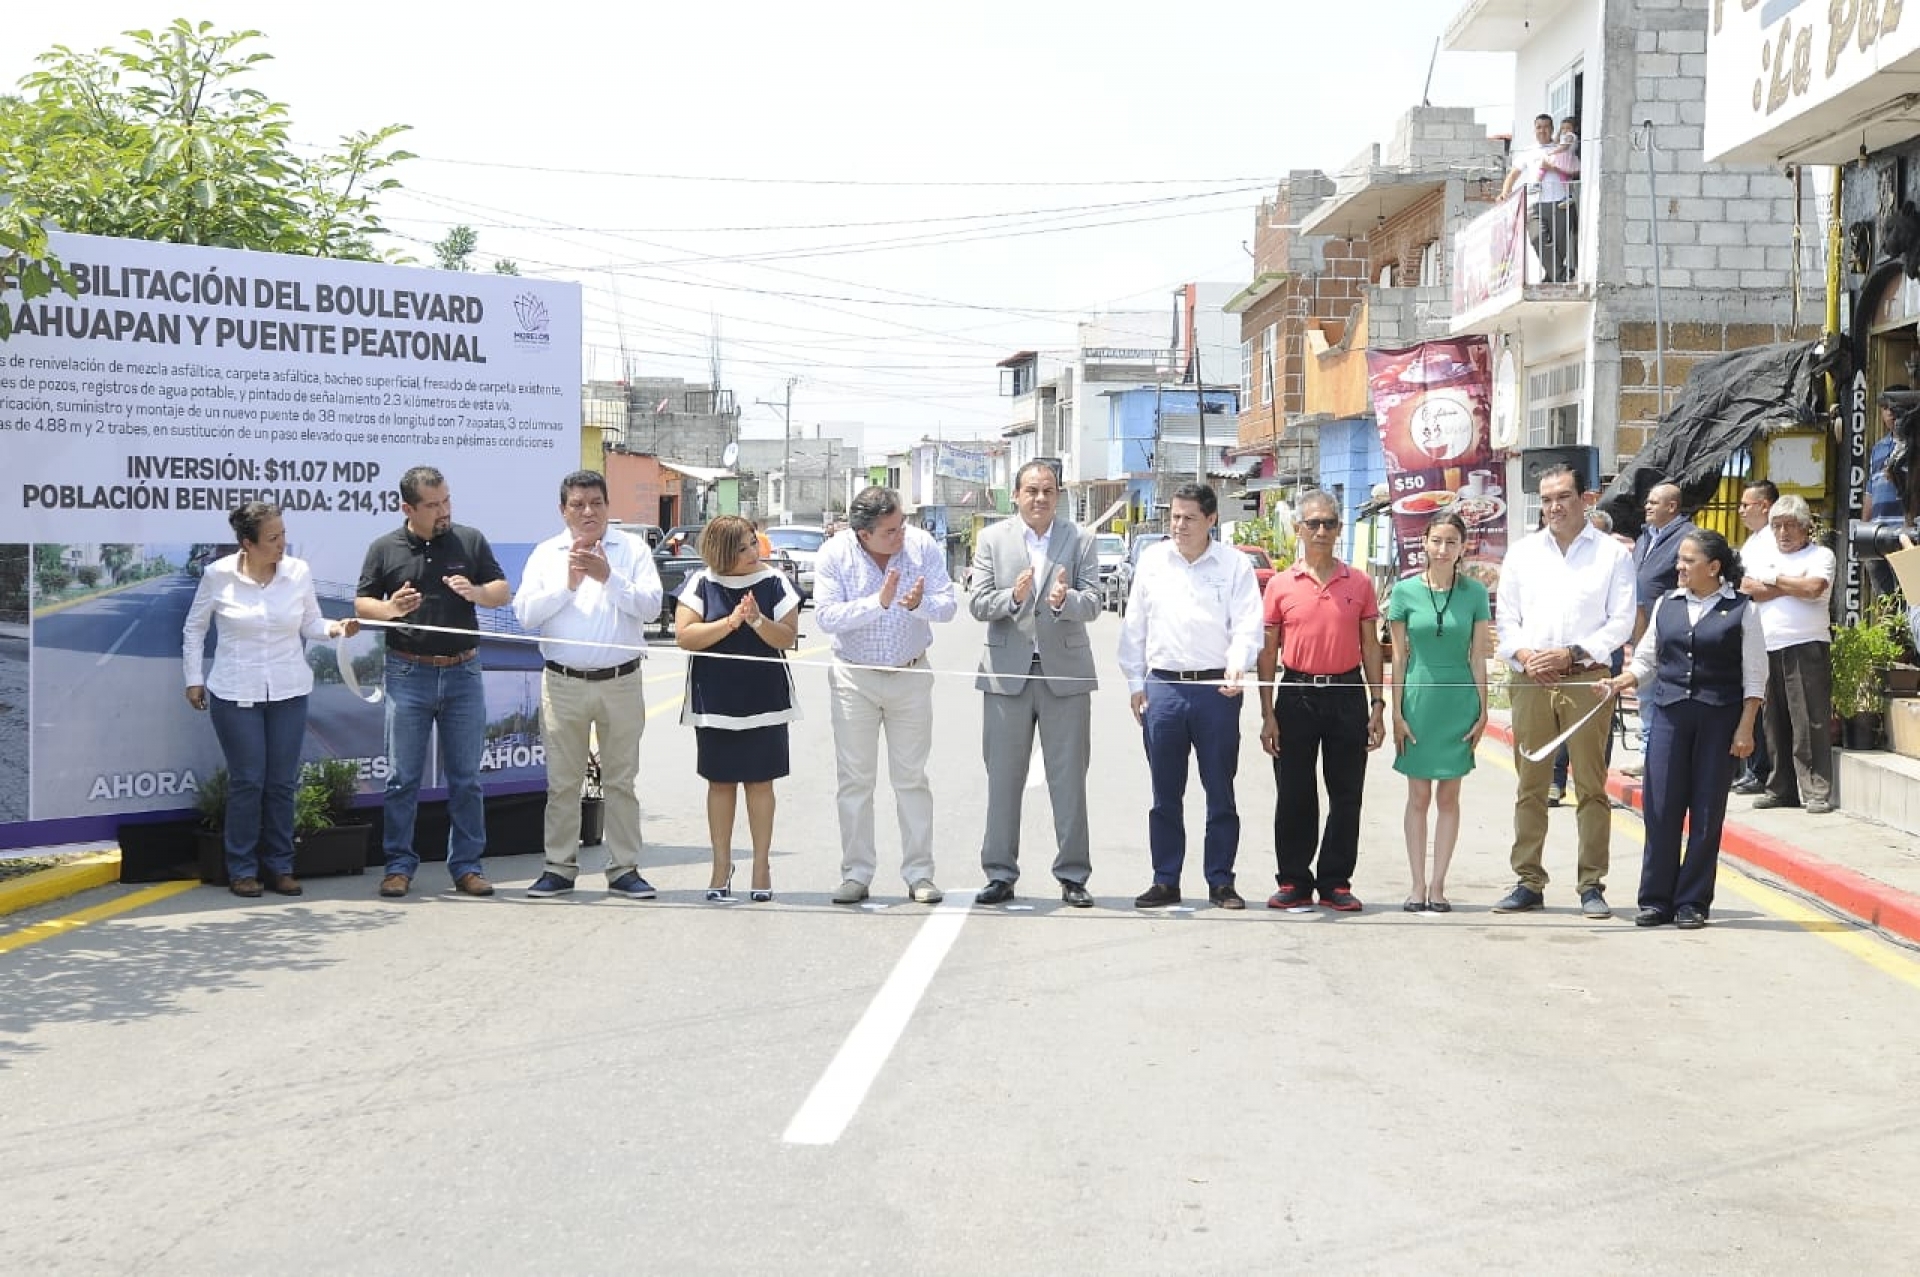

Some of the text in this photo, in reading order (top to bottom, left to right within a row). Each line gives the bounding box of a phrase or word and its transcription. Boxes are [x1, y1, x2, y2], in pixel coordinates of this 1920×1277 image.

[254, 278, 310, 312] DEL
[316, 284, 484, 325] BOULEVARD
[186, 314, 210, 346] Y
[215, 317, 336, 354] PUENTE
[341, 326, 487, 364] PEATONAL
[10, 353, 25, 368] de
[29, 355, 105, 372] renivelación
[109, 359, 124, 373] de
[127, 361, 168, 376] mezcla
[226, 368, 270, 383] carpeta
[324, 372, 364, 386] bacheo
[464, 379, 478, 392] de
[479, 381, 517, 396] carpeta
[20, 375, 35, 389] de
[39, 379, 79, 394] pozos,
[82, 379, 138, 397] registros
[140, 381, 155, 395] de
[158, 386, 188, 400] agua
[239, 389, 247, 402] y
[248, 387, 292, 403] pintado
[293, 389, 307, 402] de
[310, 390, 381, 406] señalamiento
[458, 398, 471, 409] de
[473, 399, 494, 411] esta
[57, 398, 122, 414] suministro
[125, 404, 133, 418] y
[136, 403, 185, 419] montaje
[187, 404, 202, 417] de
[205, 407, 220, 419] un
[223, 408, 257, 420] nuevo
[260, 409, 300, 423] puente
[302, 409, 316, 422] de
[319, 409, 335, 423] 38
[338, 412, 376, 424] metros
[377, 411, 391, 425] de
[393, 413, 435, 429] longitud
[437, 417, 455, 427] con
[457, 415, 465, 428] 7
[507, 416, 517, 430] 3
[1851, 368, 1867, 457] AROS
[15, 416, 31, 431] de
[34, 417, 67, 433] 4.88
[70, 422, 82, 433] m
[85, 422, 93, 437] y
[95, 419, 105, 433] 2
[152, 424, 168, 436] en
[237, 426, 252, 439] de
[254, 429, 269, 439] un
[271, 430, 298, 444] paso
[300, 428, 342, 442] elevado
[344, 432, 364, 444] que
[366, 433, 379, 443] se
[380, 432, 439, 445] encontraba
[441, 435, 455, 445] en
[456, 433, 496, 448] pésimas
[499, 435, 554, 448] condiciones
[127, 453, 380, 483] INVERSIÓN: $11.07 MDP
[1394, 475, 1425, 492] $50
[23, 480, 169, 510] POBLACIÓN
[337, 489, 400, 516] 214,13
[1849, 465, 1866, 510] DE
[479, 745, 546, 771] AHOR
[88, 769, 199, 801] AHORA
